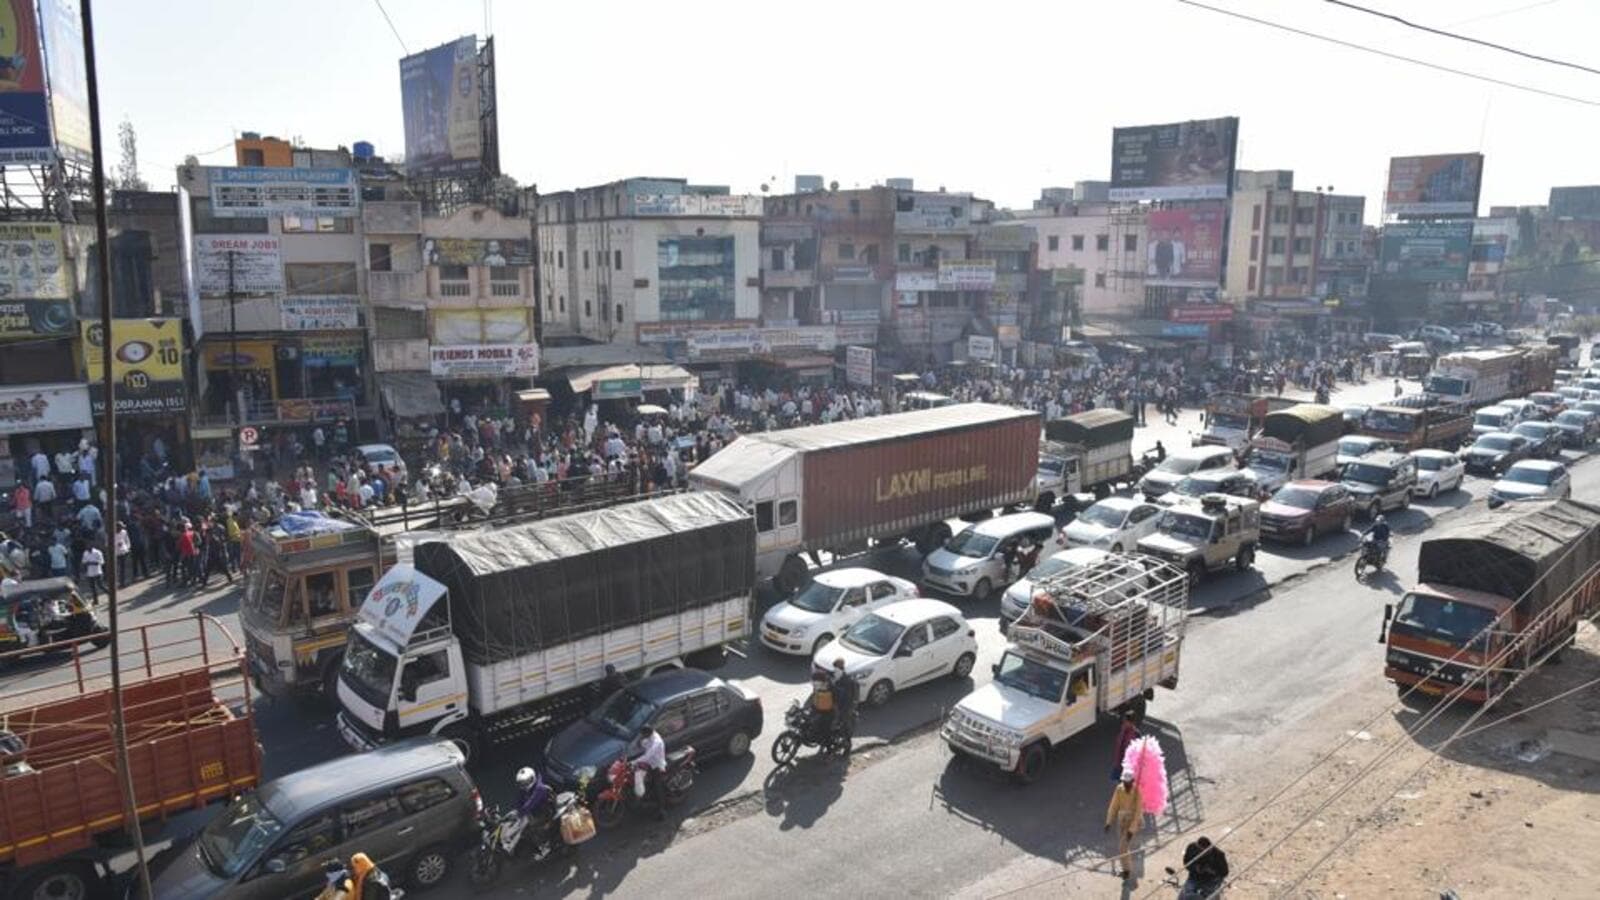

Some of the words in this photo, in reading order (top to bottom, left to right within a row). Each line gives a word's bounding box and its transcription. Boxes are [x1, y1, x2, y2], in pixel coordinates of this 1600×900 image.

[212, 240, 247, 249] DREAM
[250, 240, 277, 249] JOBS
[159, 347, 178, 365] 10
[433, 349, 474, 360] FRIENDS
[478, 348, 512, 359] MOBILE
[876, 467, 931, 502] LAXMI
